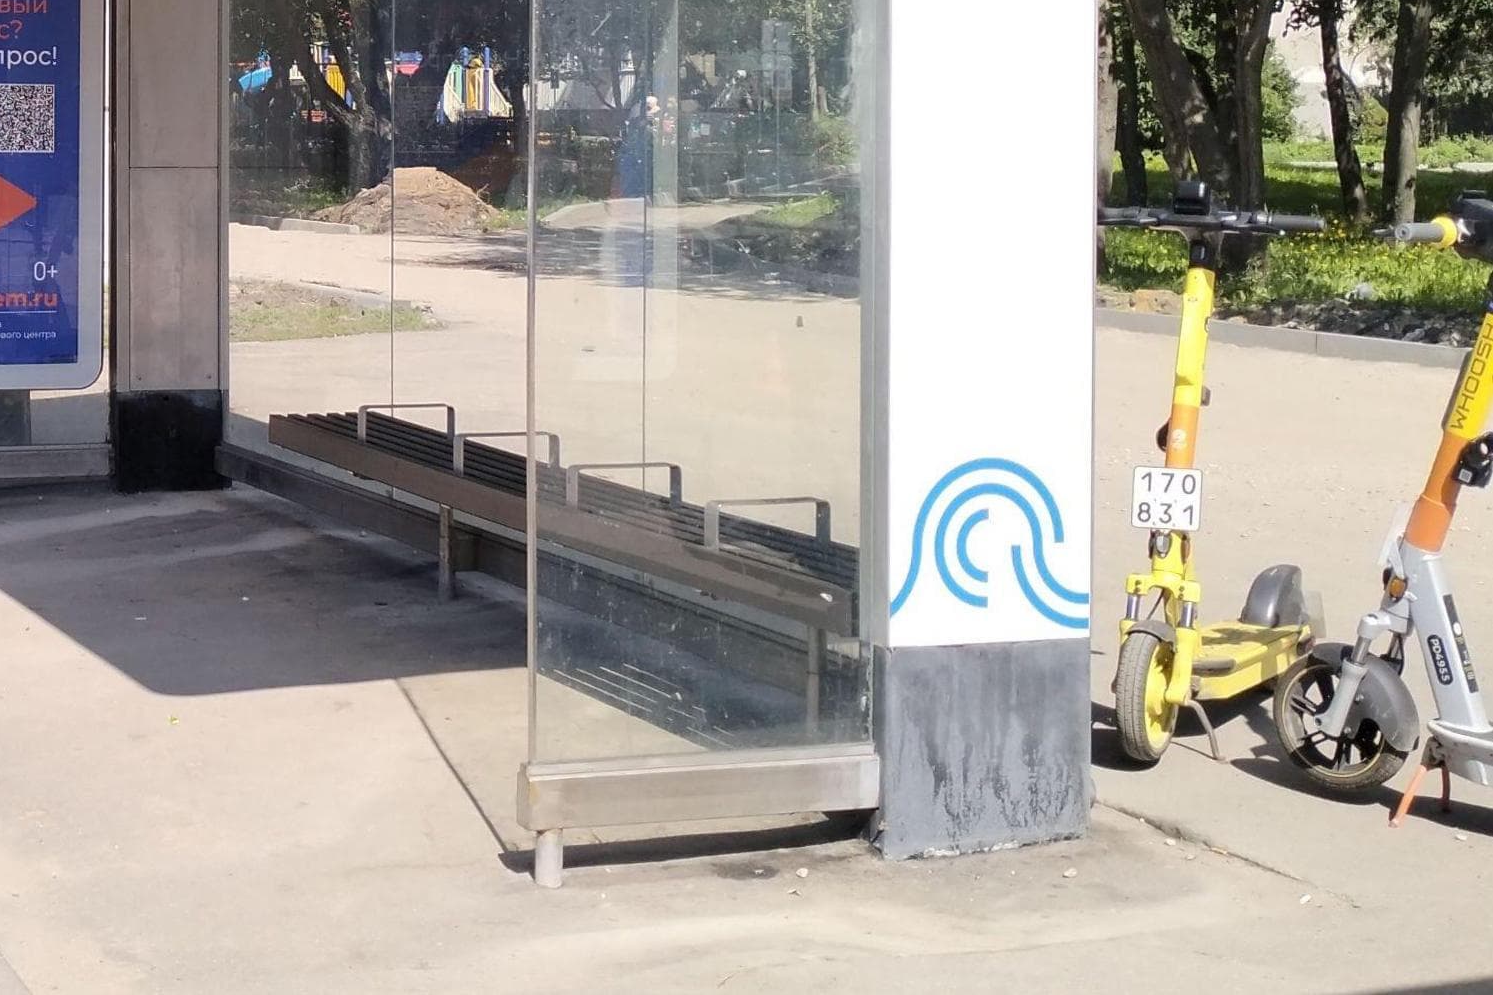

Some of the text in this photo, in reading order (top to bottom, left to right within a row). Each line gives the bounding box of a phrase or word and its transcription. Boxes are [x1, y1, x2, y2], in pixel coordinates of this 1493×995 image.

[33, 261, 58, 282] 0+
[1141, 471, 1197, 495] 170
[1137, 501, 1194, 526] 831
